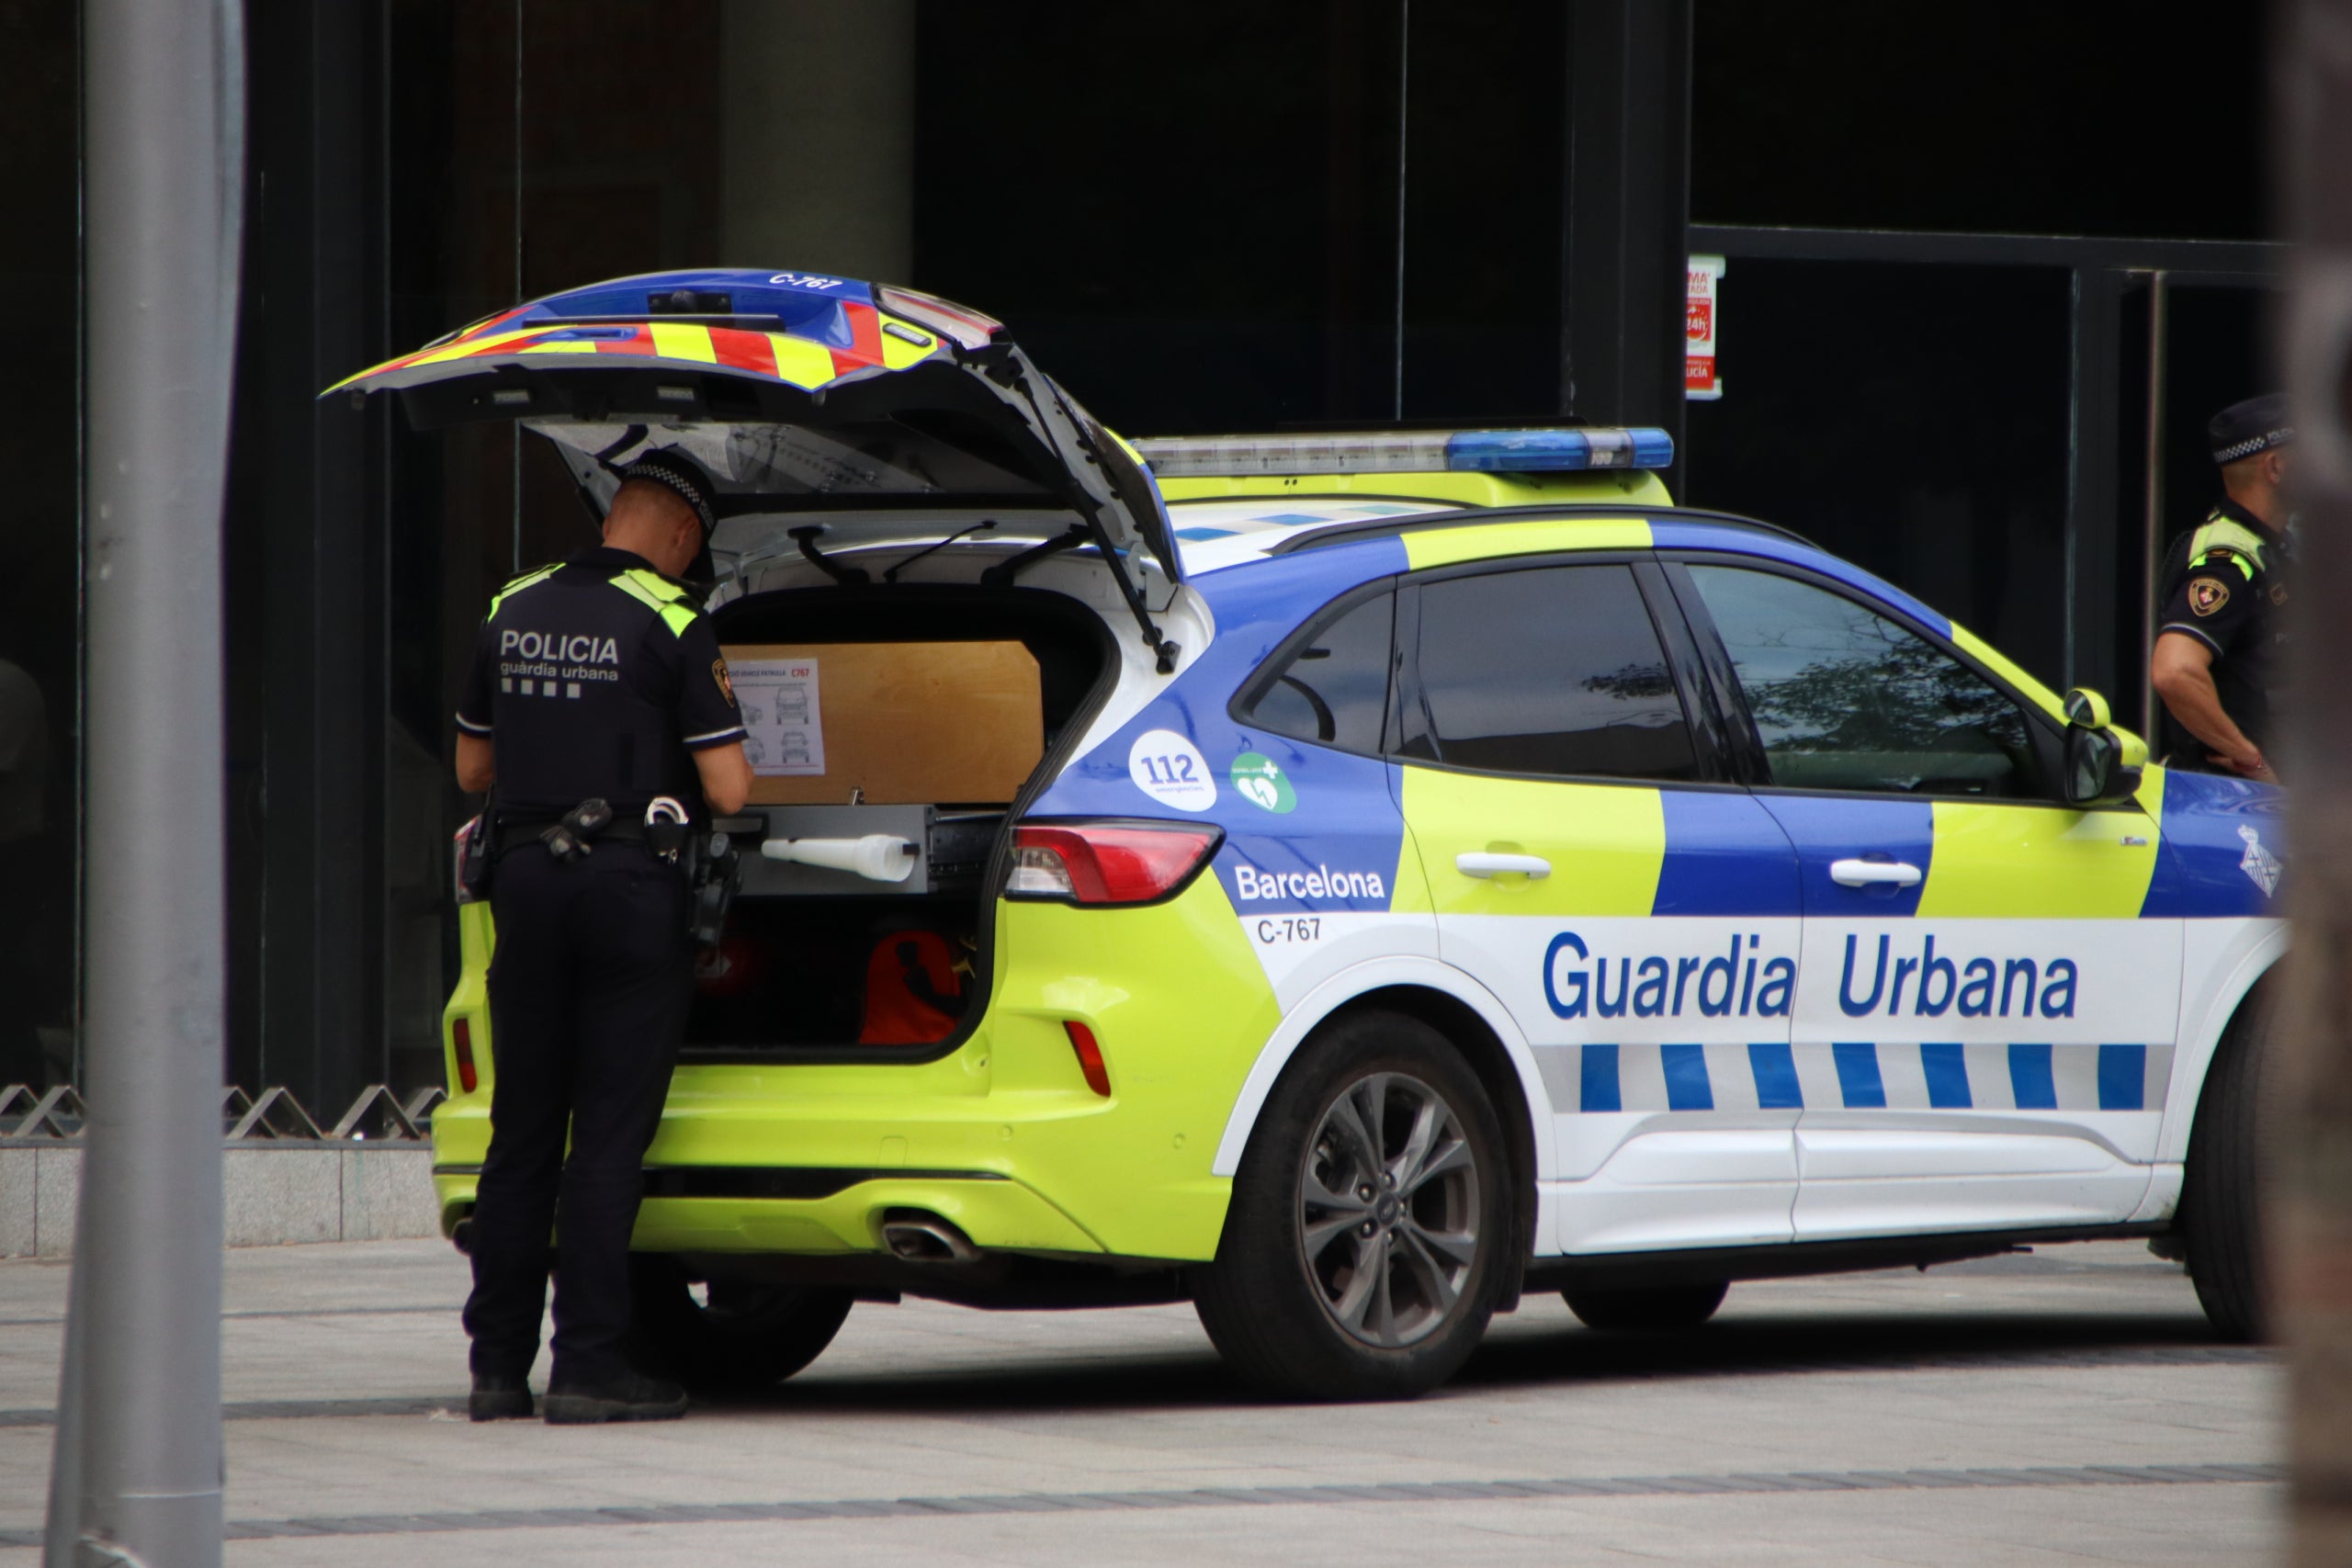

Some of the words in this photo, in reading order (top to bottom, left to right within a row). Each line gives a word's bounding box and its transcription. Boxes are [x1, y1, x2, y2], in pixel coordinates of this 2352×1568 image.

[769, 273, 843, 290] C-767
[500, 629, 618, 664] POLICIA
[561, 665, 618, 681] urbana
[791, 668, 809, 678] C767
[1140, 753, 1199, 785] 112
[1234, 864, 1385, 900] Barcelona
[1258, 918, 1320, 944] C-767
[1543, 931, 1797, 1020] Guardia
[1838, 933, 2078, 1020] Urbana
